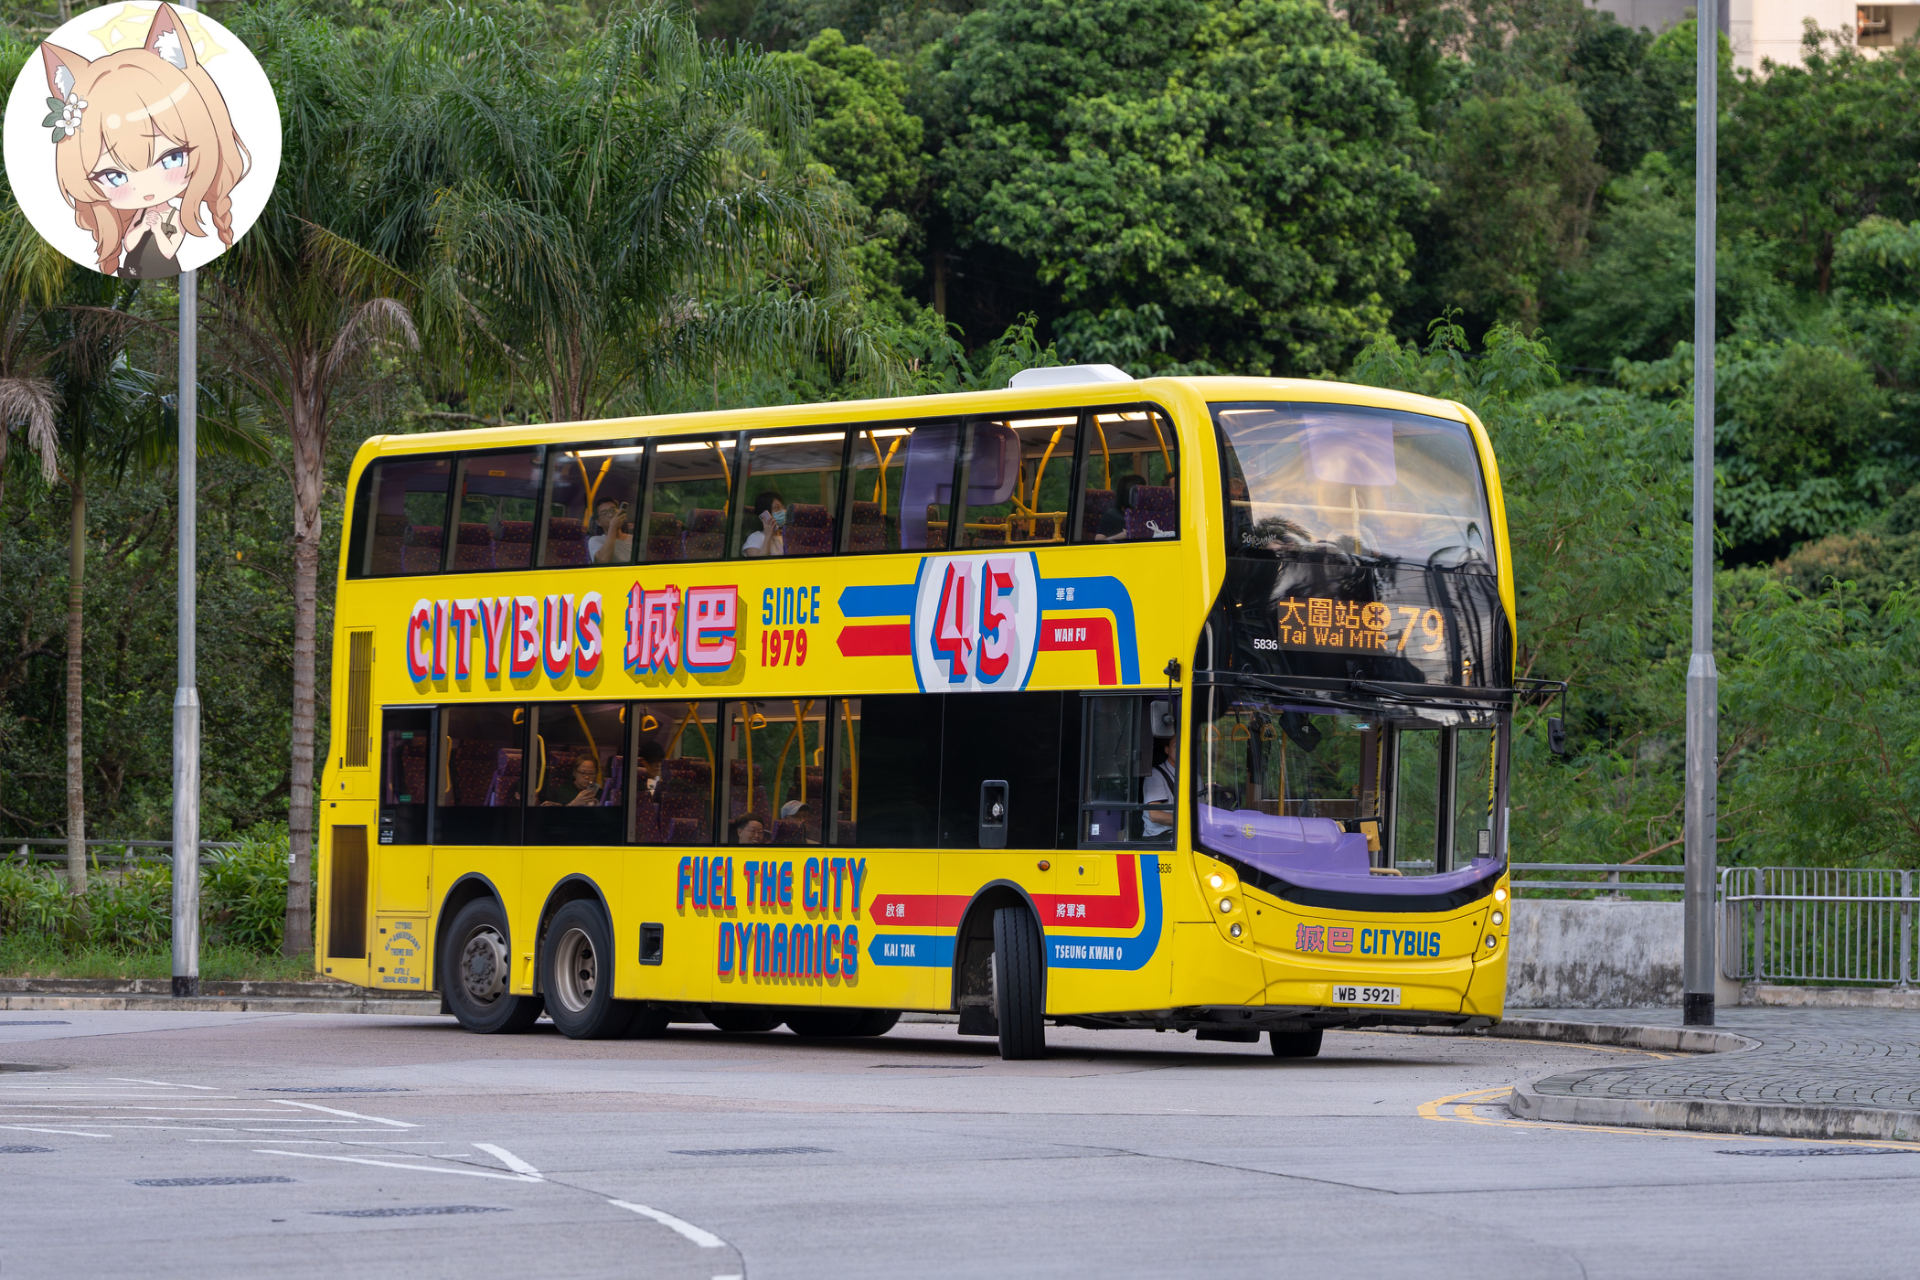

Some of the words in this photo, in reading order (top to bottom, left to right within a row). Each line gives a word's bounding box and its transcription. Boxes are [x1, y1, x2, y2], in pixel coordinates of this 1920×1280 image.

[762, 586, 821, 626] SINCE
[1055, 586, 1075, 602] 華富
[930, 557, 1017, 685] 45
[1279, 597, 1360, 629] 大圍站
[406, 591, 603, 684] CITYBUS
[624, 580, 739, 676] 城巴
[1054, 628, 1074, 643] WAH
[1075, 627, 1087, 642] FU
[1280, 625, 1307, 645] Tai
[1313, 627, 1344, 648] Wai
[1350, 630, 1389, 650] MTR
[1397, 606, 1444, 653] 79
[761, 629, 808, 668] 1979
[1253, 638, 1278, 650] 5836
[1156, 863, 1172, 874] 5836
[676, 856, 737, 911] FUEL
[743, 861, 793, 907] THE
[802, 857, 867, 912] CITY
[885, 903, 906, 918] 啟德
[1056, 903, 1086, 918] 將軍澳
[717, 922, 859, 980] DYNAMICS
[884, 943, 899, 957] KAI
[900, 944, 916, 958] TAK
[1296, 922, 1354, 954] 城巴
[1360, 928, 1441, 957] CITYBUS
[1055, 945, 1087, 959] TSEUNG
[1088, 945, 1115, 960] KWAN
[1116, 946, 1122, 961] O
[1338, 987, 1357, 1001] WB
[1362, 987, 1395, 1003] 5921
